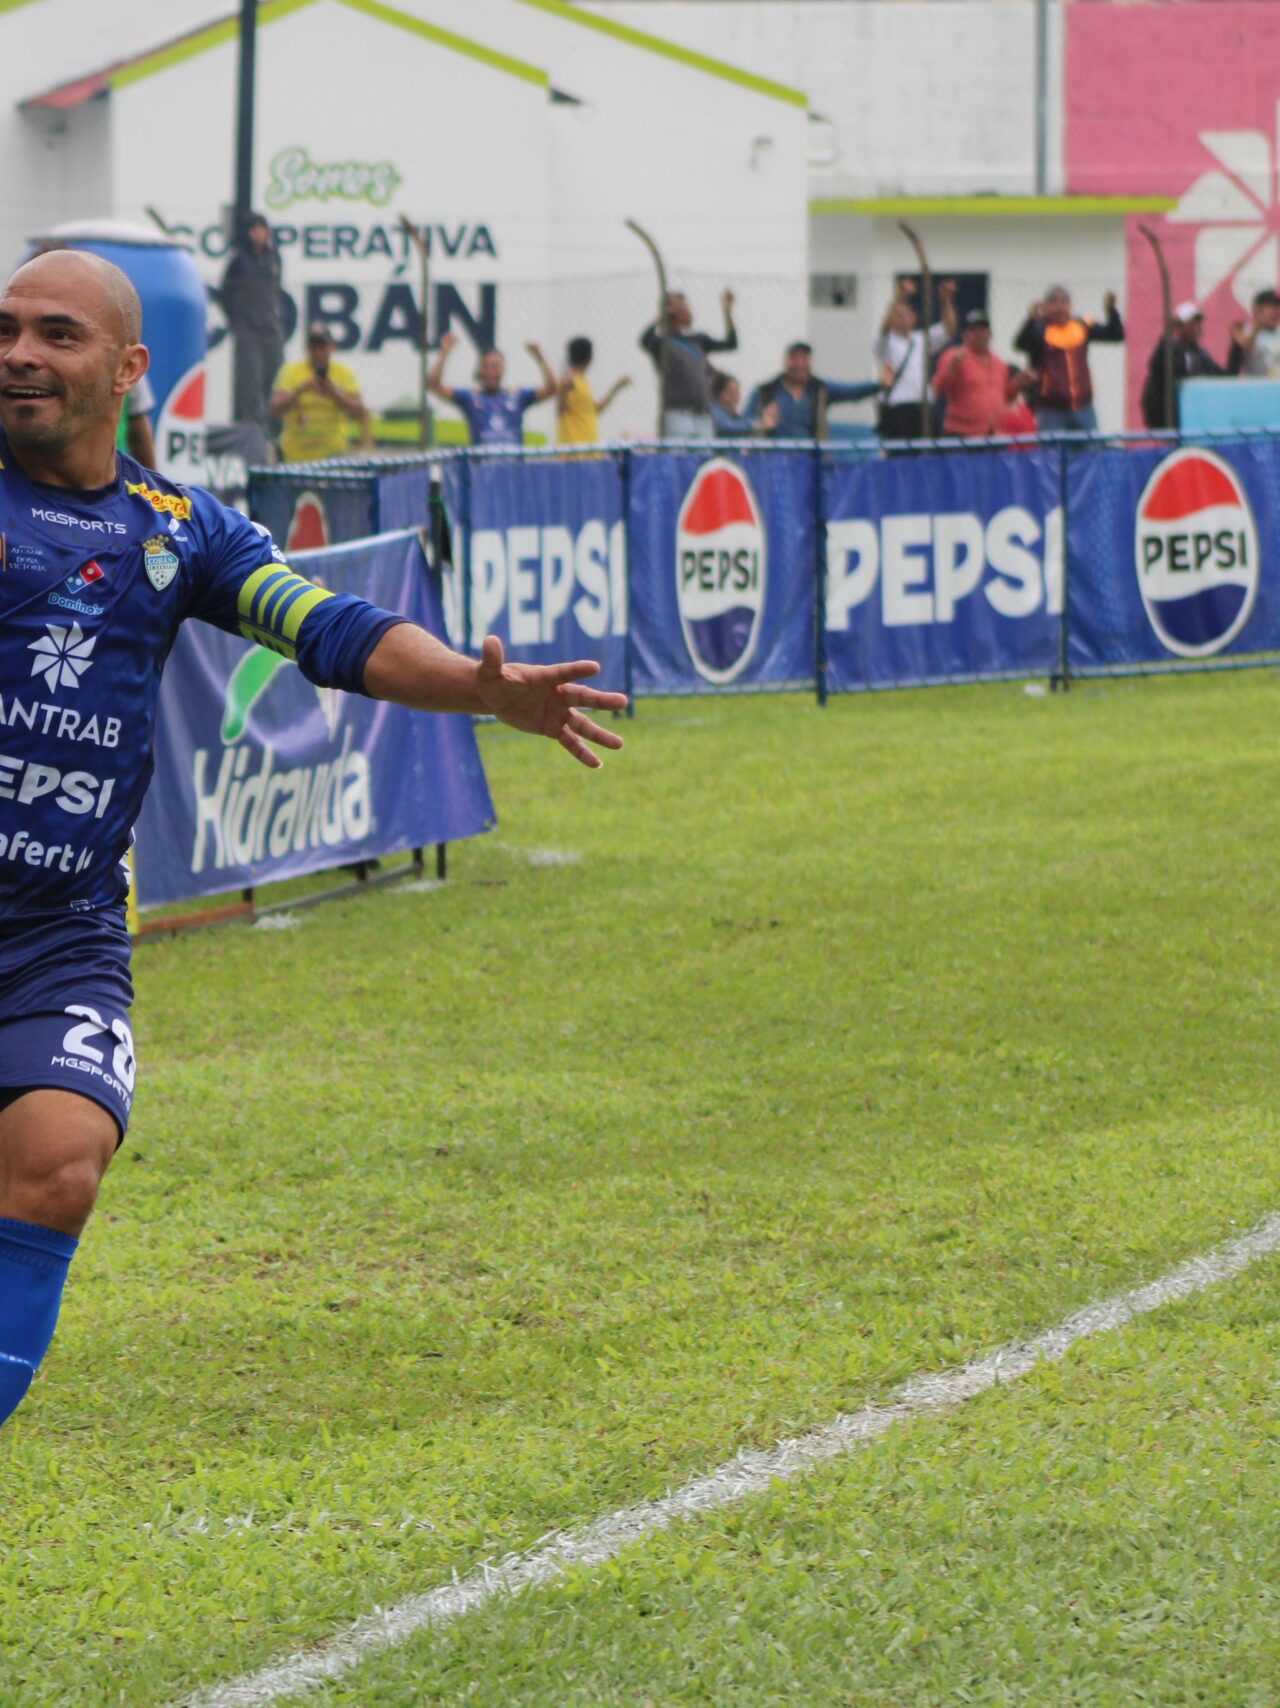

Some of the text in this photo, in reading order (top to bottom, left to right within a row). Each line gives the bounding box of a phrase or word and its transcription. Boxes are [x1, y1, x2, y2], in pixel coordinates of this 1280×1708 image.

[265, 147, 402, 210] Somos
[169, 223, 498, 259] COPERATIVA
[31, 507, 128, 535] MGSPORTS
[681, 549, 759, 593] PEPSI
[825, 506, 1064, 632] PEPSI
[1143, 530, 1248, 574] PEPSI
[471, 519, 627, 650] PEPSI
[50, 1055, 132, 1112] MGSPORTS
